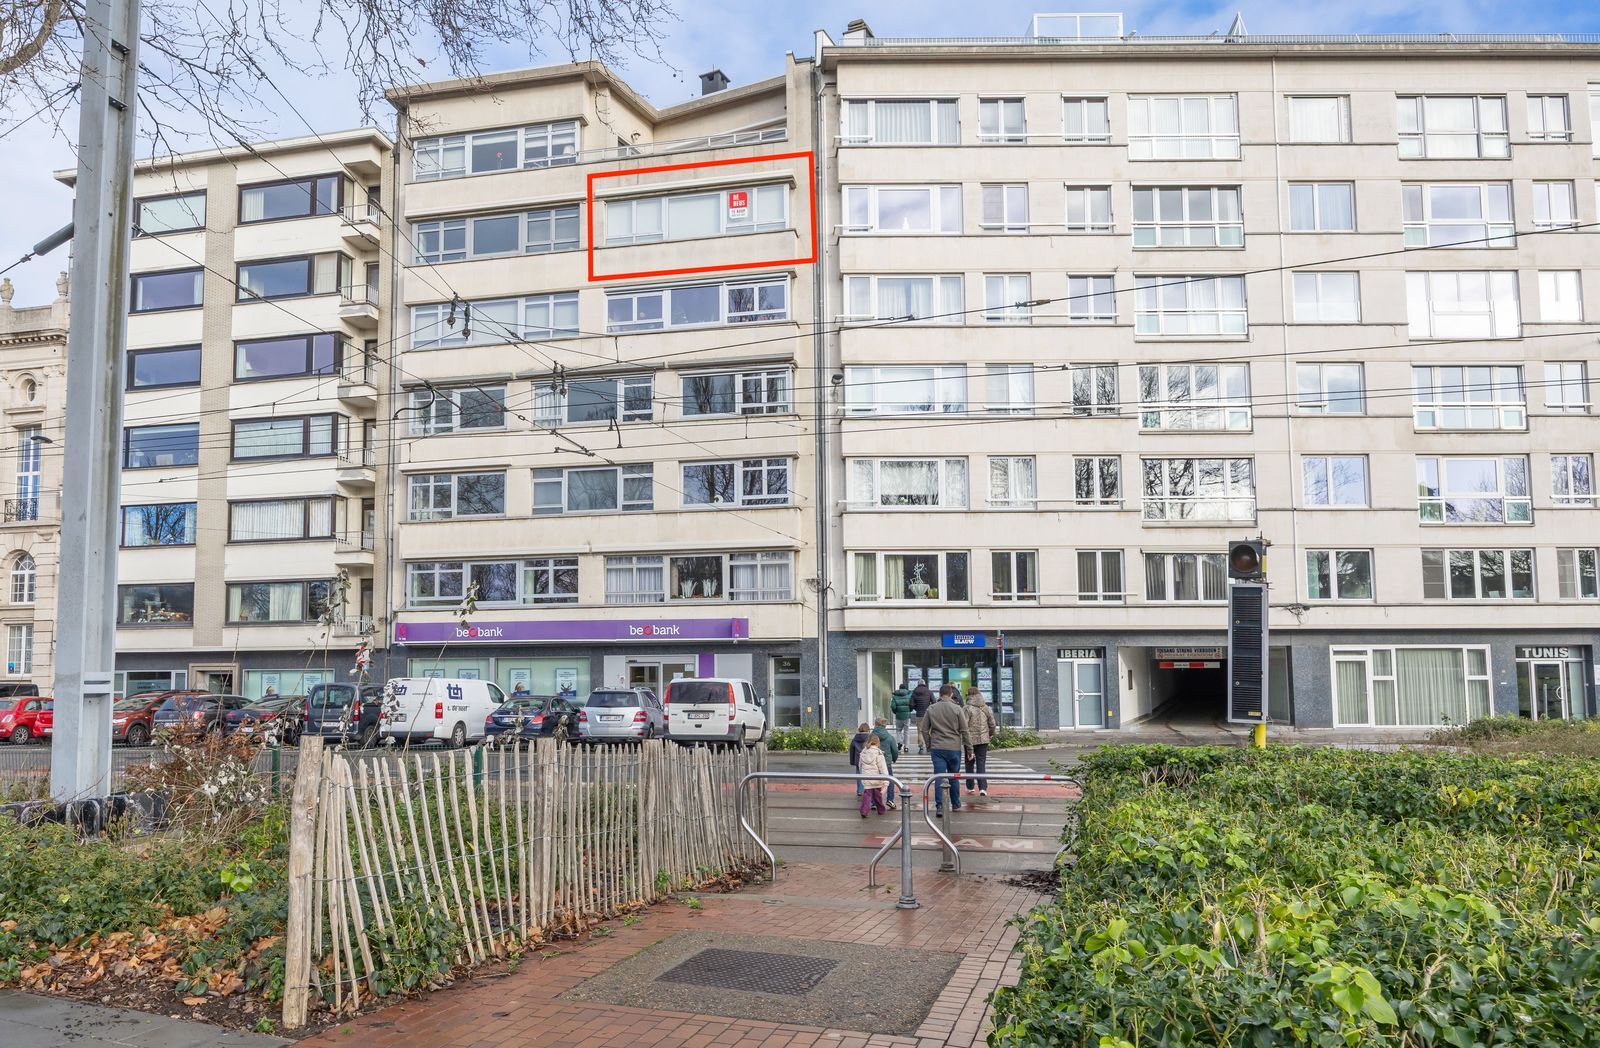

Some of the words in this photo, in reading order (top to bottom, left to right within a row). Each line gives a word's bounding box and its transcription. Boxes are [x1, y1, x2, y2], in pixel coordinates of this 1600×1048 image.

[456, 627, 503, 638] beobank
[629, 625, 680, 635] beobank
[1060, 649, 1097, 658] IBERIA
[1522, 647, 1569, 658] TUNIS
[875, 835, 1034, 849] TRAM
